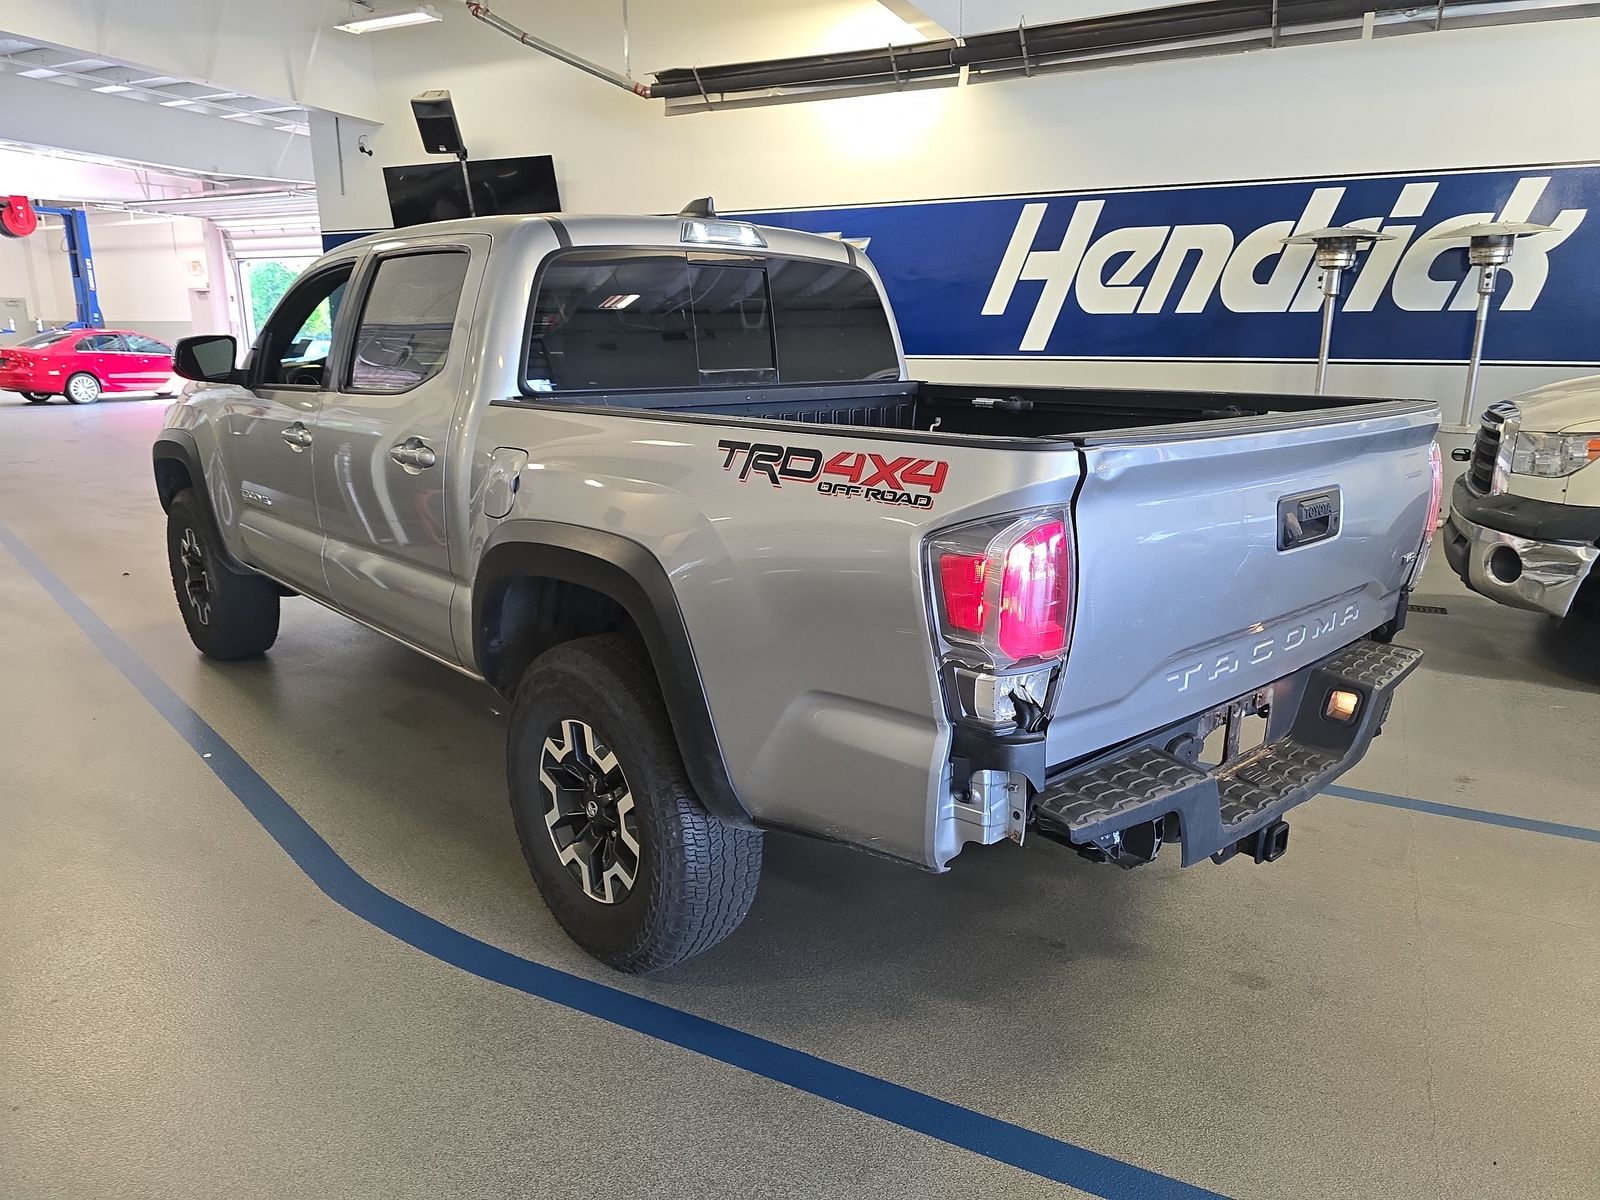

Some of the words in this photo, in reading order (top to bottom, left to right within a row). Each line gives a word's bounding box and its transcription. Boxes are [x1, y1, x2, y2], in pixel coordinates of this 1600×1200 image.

[981, 177, 1587, 351] Hendrick
[718, 440, 824, 488] TRD
[817, 481, 862, 499] OFF
[864, 488, 935, 510] ROAD
[1303, 502, 1332, 519] TOYOTA
[1166, 601, 1361, 692] TACOMA
